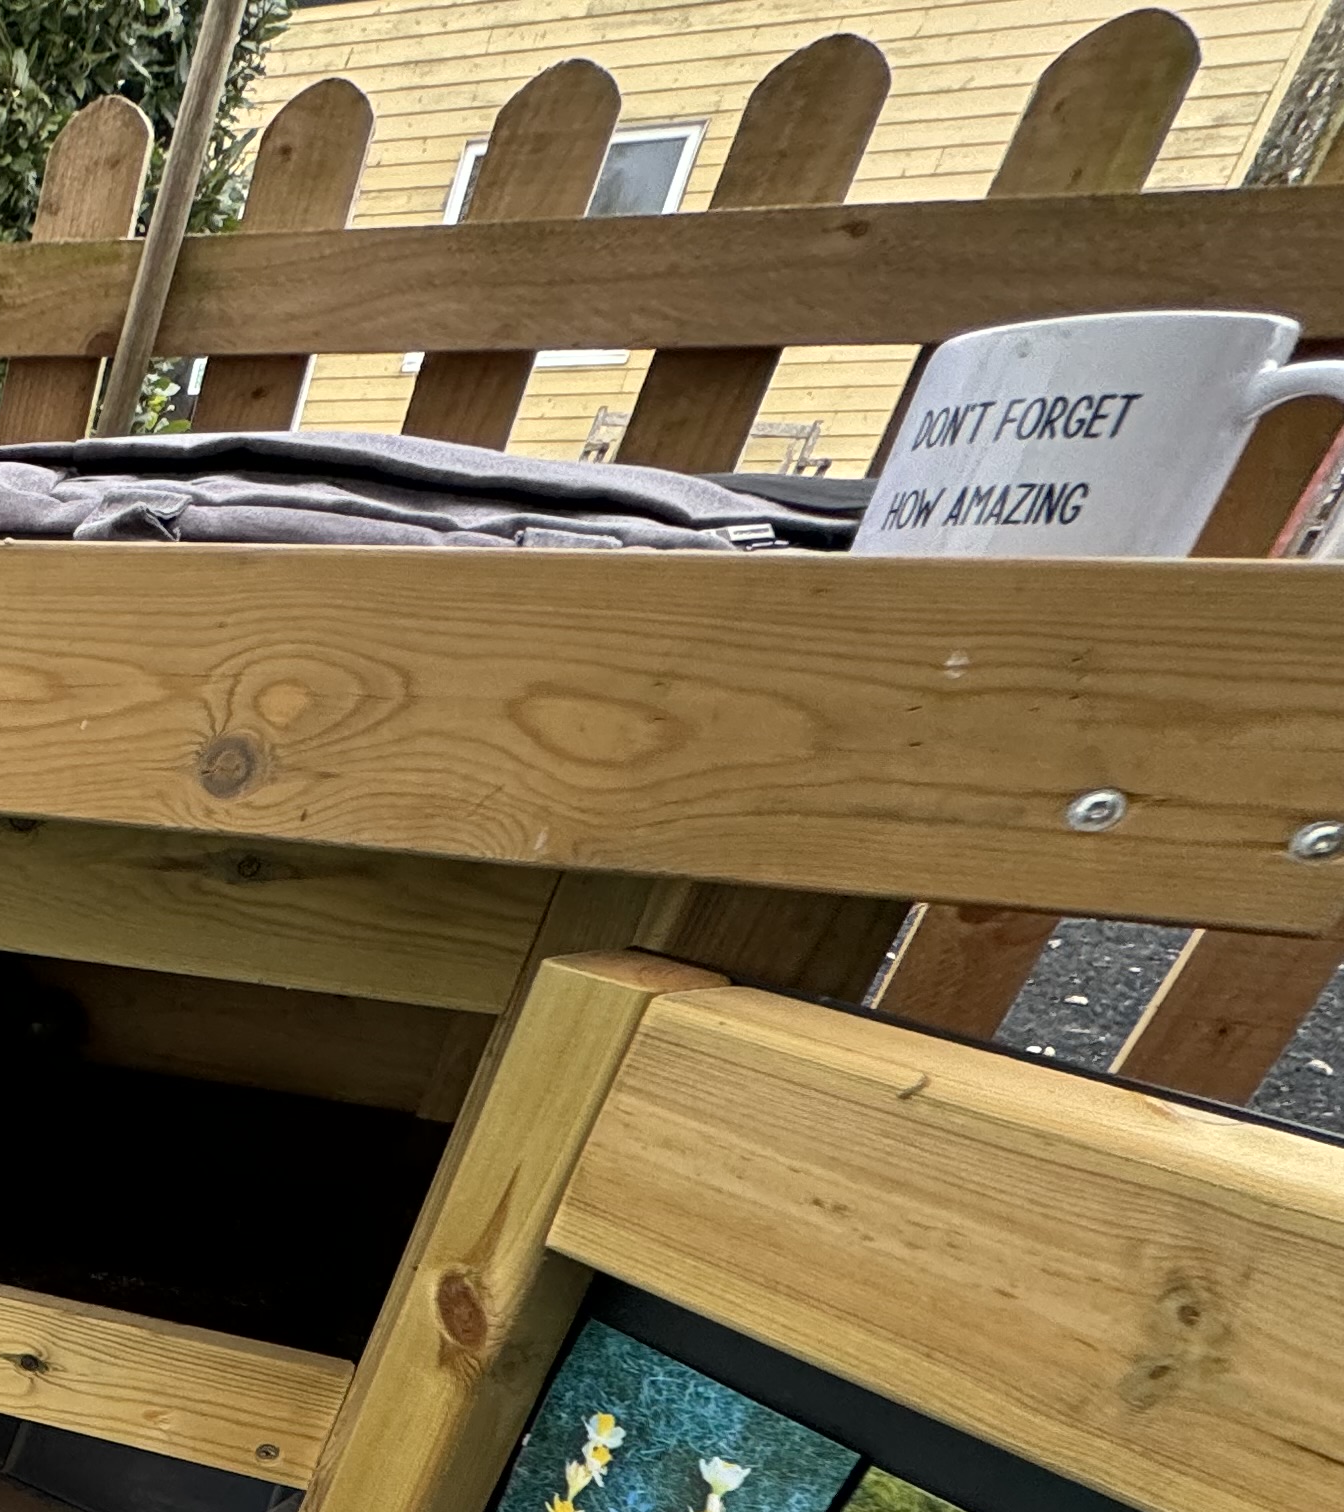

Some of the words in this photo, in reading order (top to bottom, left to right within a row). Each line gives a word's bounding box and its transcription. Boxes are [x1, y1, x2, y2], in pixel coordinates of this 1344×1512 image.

[911, 400, 998, 451] DON'T
[993, 393, 1146, 442] FORGET
[881, 490, 937, 531] HOW
[943, 483, 1090, 527] AMAZING
